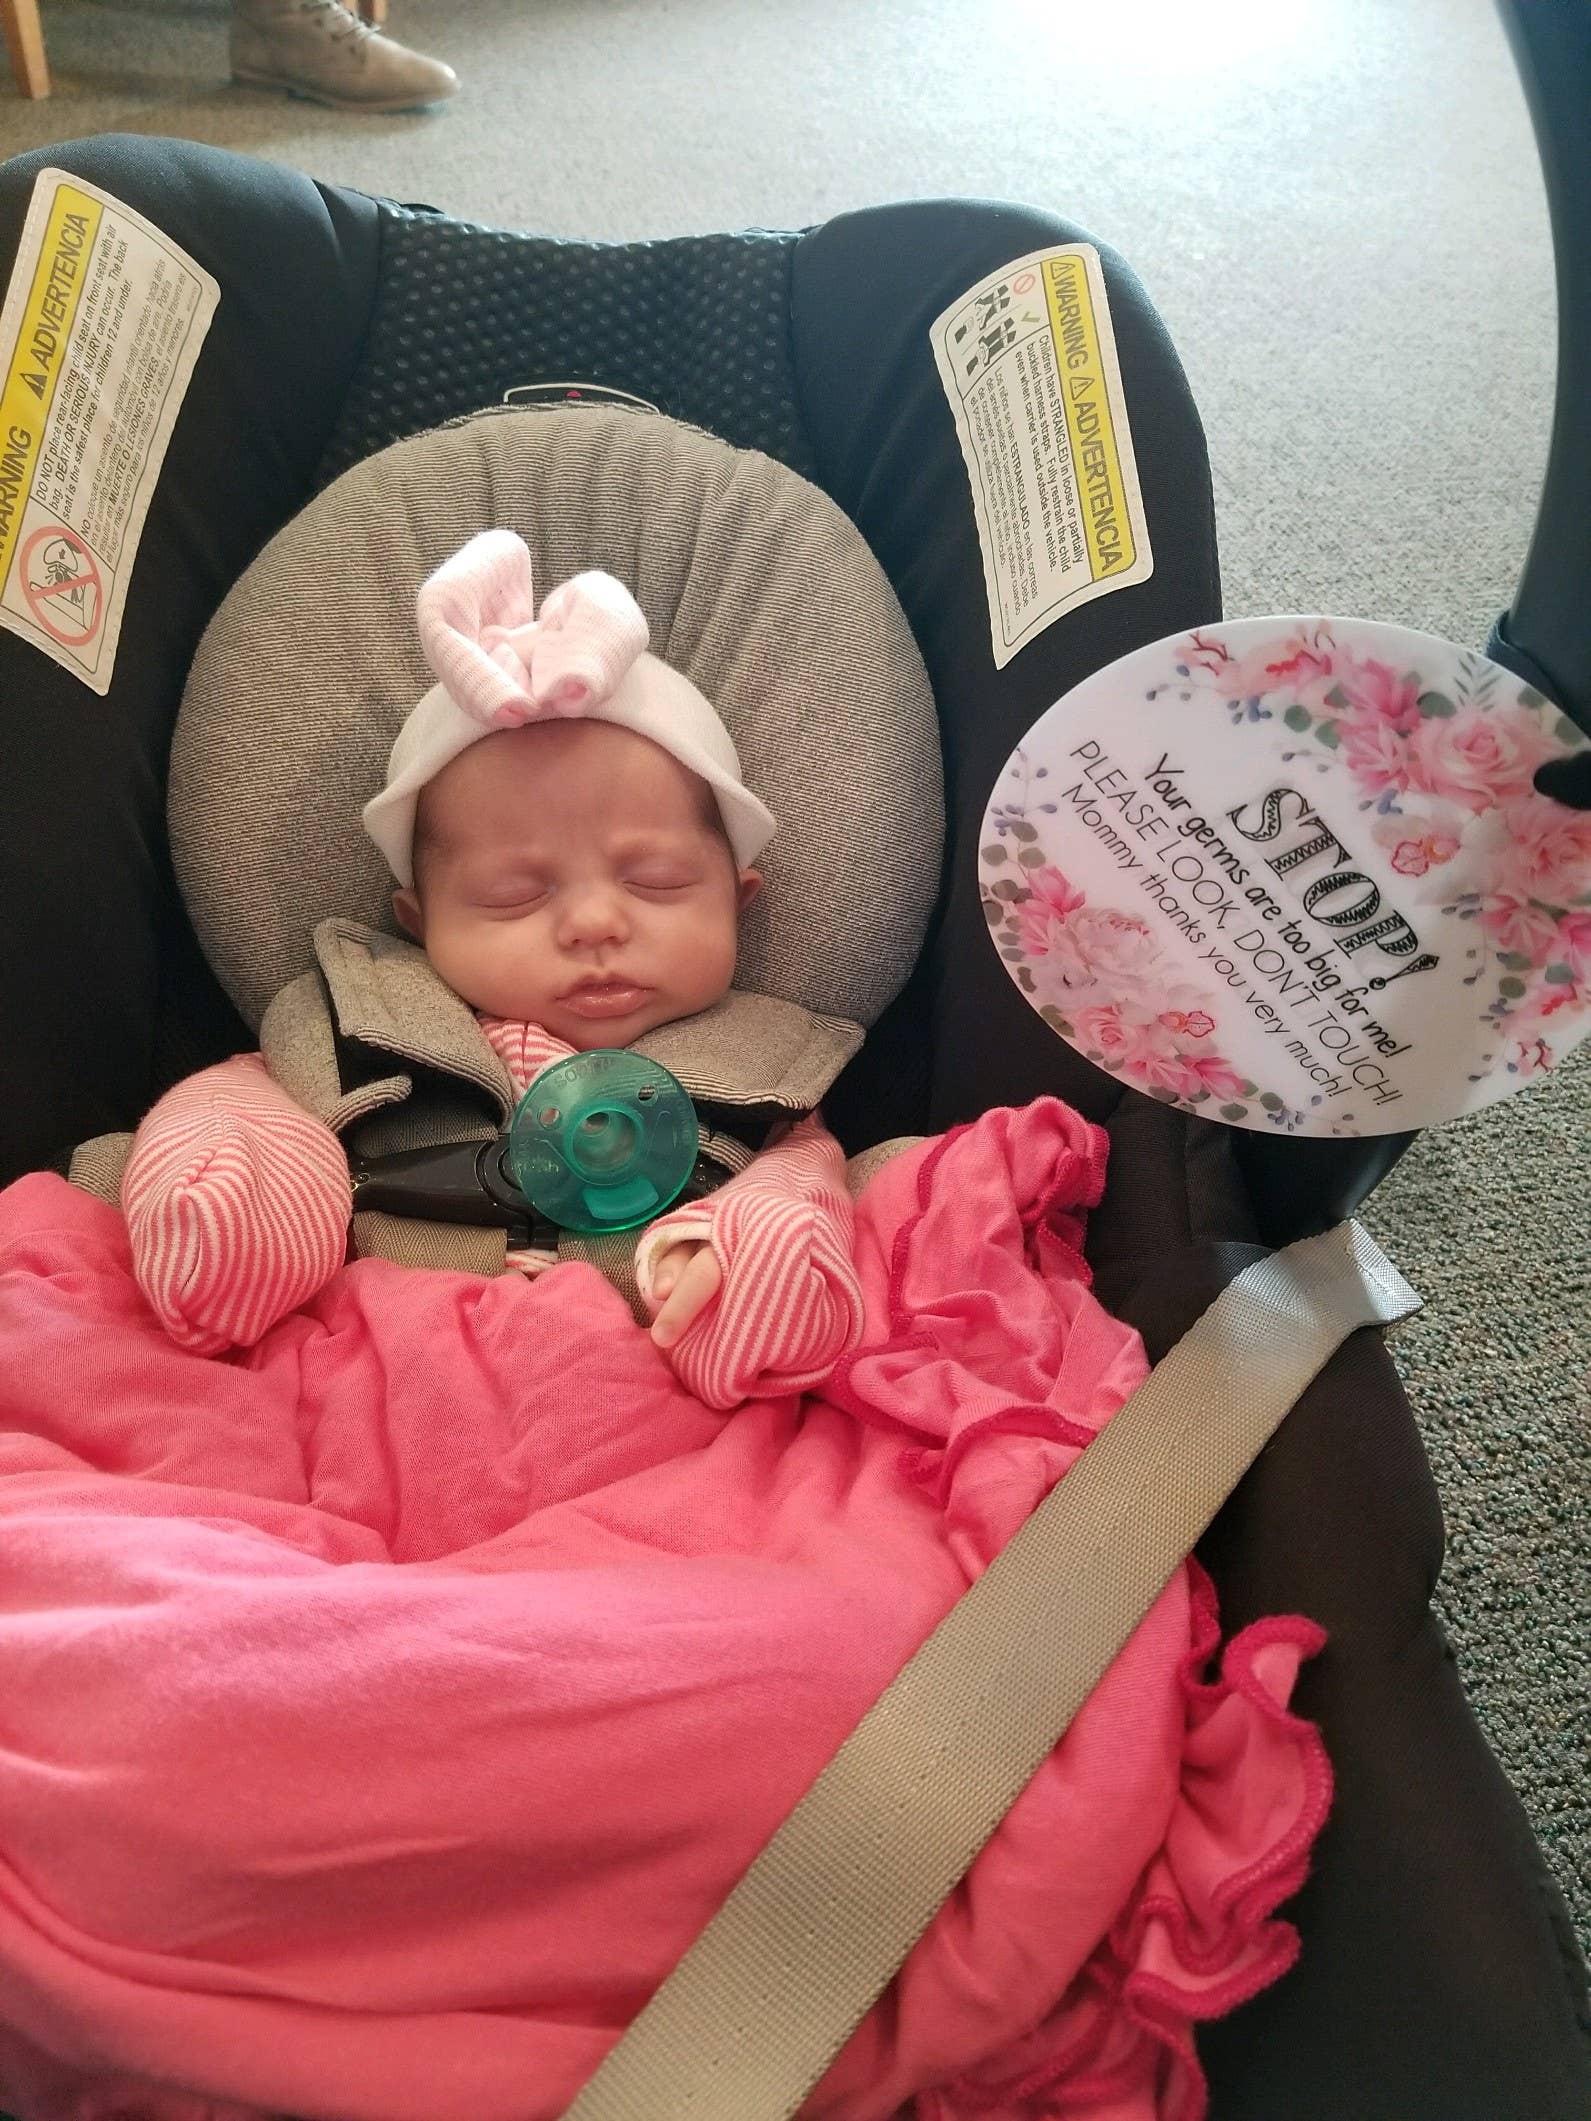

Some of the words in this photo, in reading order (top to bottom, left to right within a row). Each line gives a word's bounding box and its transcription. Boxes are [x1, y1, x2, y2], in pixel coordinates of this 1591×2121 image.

[105, 223, 116, 238] air
[99, 238, 112, 258] with
[114, 239, 127, 263] back
[94, 257, 107, 280] seat
[109, 262, 121, 280] The
[31, 213, 90, 372] ADVERTENCIA
[87, 280, 101, 305] front
[102, 286, 115, 315] occur.
[117, 278, 132, 309] under.
[86, 305, 94, 319] on
[96, 317, 106, 335] can
[111, 307, 123, 329] and
[1055, 274, 1088, 370] WARNING
[78, 317, 91, 342] seat
[108, 328, 117, 341] 12
[147, 328, 156, 341] de
[70, 340, 84, 368] child
[83, 333, 101, 374] INJURY
[94, 342, 112, 385] children
[140, 341, 152, 366] bolsa
[1015, 351, 1025, 374] even
[1027, 342, 1039, 379] buckled
[1040, 334, 1052, 373] Children
[136, 367, 145, 383] con
[1046, 373, 1057, 398] have
[55, 368, 79, 425] rear-facing
[70, 374, 90, 424] SERIOUS
[91, 384, 101, 400] for
[978, 386, 984, 400] de
[1034, 378, 1046, 419] harness
[81, 401, 97, 432] place
[125, 398, 146, 450] LESIONES
[1026, 401, 1036, 433] carrier
[1051, 398, 1066, 463] STRANGLED
[48, 426, 64, 457] place
[64, 423, 76, 442] OR
[121, 474, 134, 506] seguro
[129, 448, 141, 475] para
[151, 384, 161, 398] 12
[156, 363, 169, 386] años
[1030, 433, 1039, 445] is
[1039, 420, 1051, 455] straps.
[73, 430, 88, 464] safest
[122, 449, 131, 460] O
[1032, 445, 1042, 473] used
[41, 454, 54, 480] NOT
[55, 443, 71, 481] DEATH
[69, 465, 80, 482] the
[104, 442, 121, 486] delantero
[1044, 457, 1057, 484] Fully
[1060, 463, 1070, 475] in
[0, 425, 32, 558] ARNING
[36, 481, 49, 500] DO
[66, 483, 76, 495] is
[81, 519, 91, 537] NO
[95, 467, 103, 481] un
[109, 419, 117, 432] de
[109, 458, 127, 504] MUERTE
[1037, 472, 1048, 510] outside
[1063, 476, 1075, 505] loose
[1073, 400, 1125, 574] ADVERTENCIA
[49, 487, 63, 510] bag.
[61, 494, 73, 519] seat
[106, 505, 114, 518] en
[1051, 485, 1063, 525] restrain
[1011, 442, 1029, 529] ESTRANGULADO
[1024, 531, 1030, 544] en
[1029, 561, 1037, 599] correas
[1042, 510, 1051, 528] the
[1067, 507, 1075, 519] or
[1056, 524, 1066, 544] the
[1068, 521, 1083, 563] partially
[1045, 528, 1057, 572] vehicle.
[1058, 545, 1070, 572] child
[1226, 788, 1440, 990] STOP!
[1144, 752, 1192, 811] Your
[1177, 817, 1250, 885] germs
[1244, 886, 1282, 921] are
[1277, 919, 1311, 955] too
[1304, 948, 1342, 992] big
[1334, 986, 1369, 1016] for
[1361, 1020, 1413, 1058] me!
[1069, 740, 1170, 842] PLEASE
[1155, 839, 1241, 930] LOOK,
[1233, 929, 1321, 1008] DON'T
[1307, 1010, 1403, 1106] TOUCH!
[1061, 783, 1144, 869] Mommy
[1139, 873, 1207, 944] thanks
[1197, 946, 1247, 988] you
[1245, 990, 1291, 1034] very
[1284, 1040, 1353, 1097] much!
